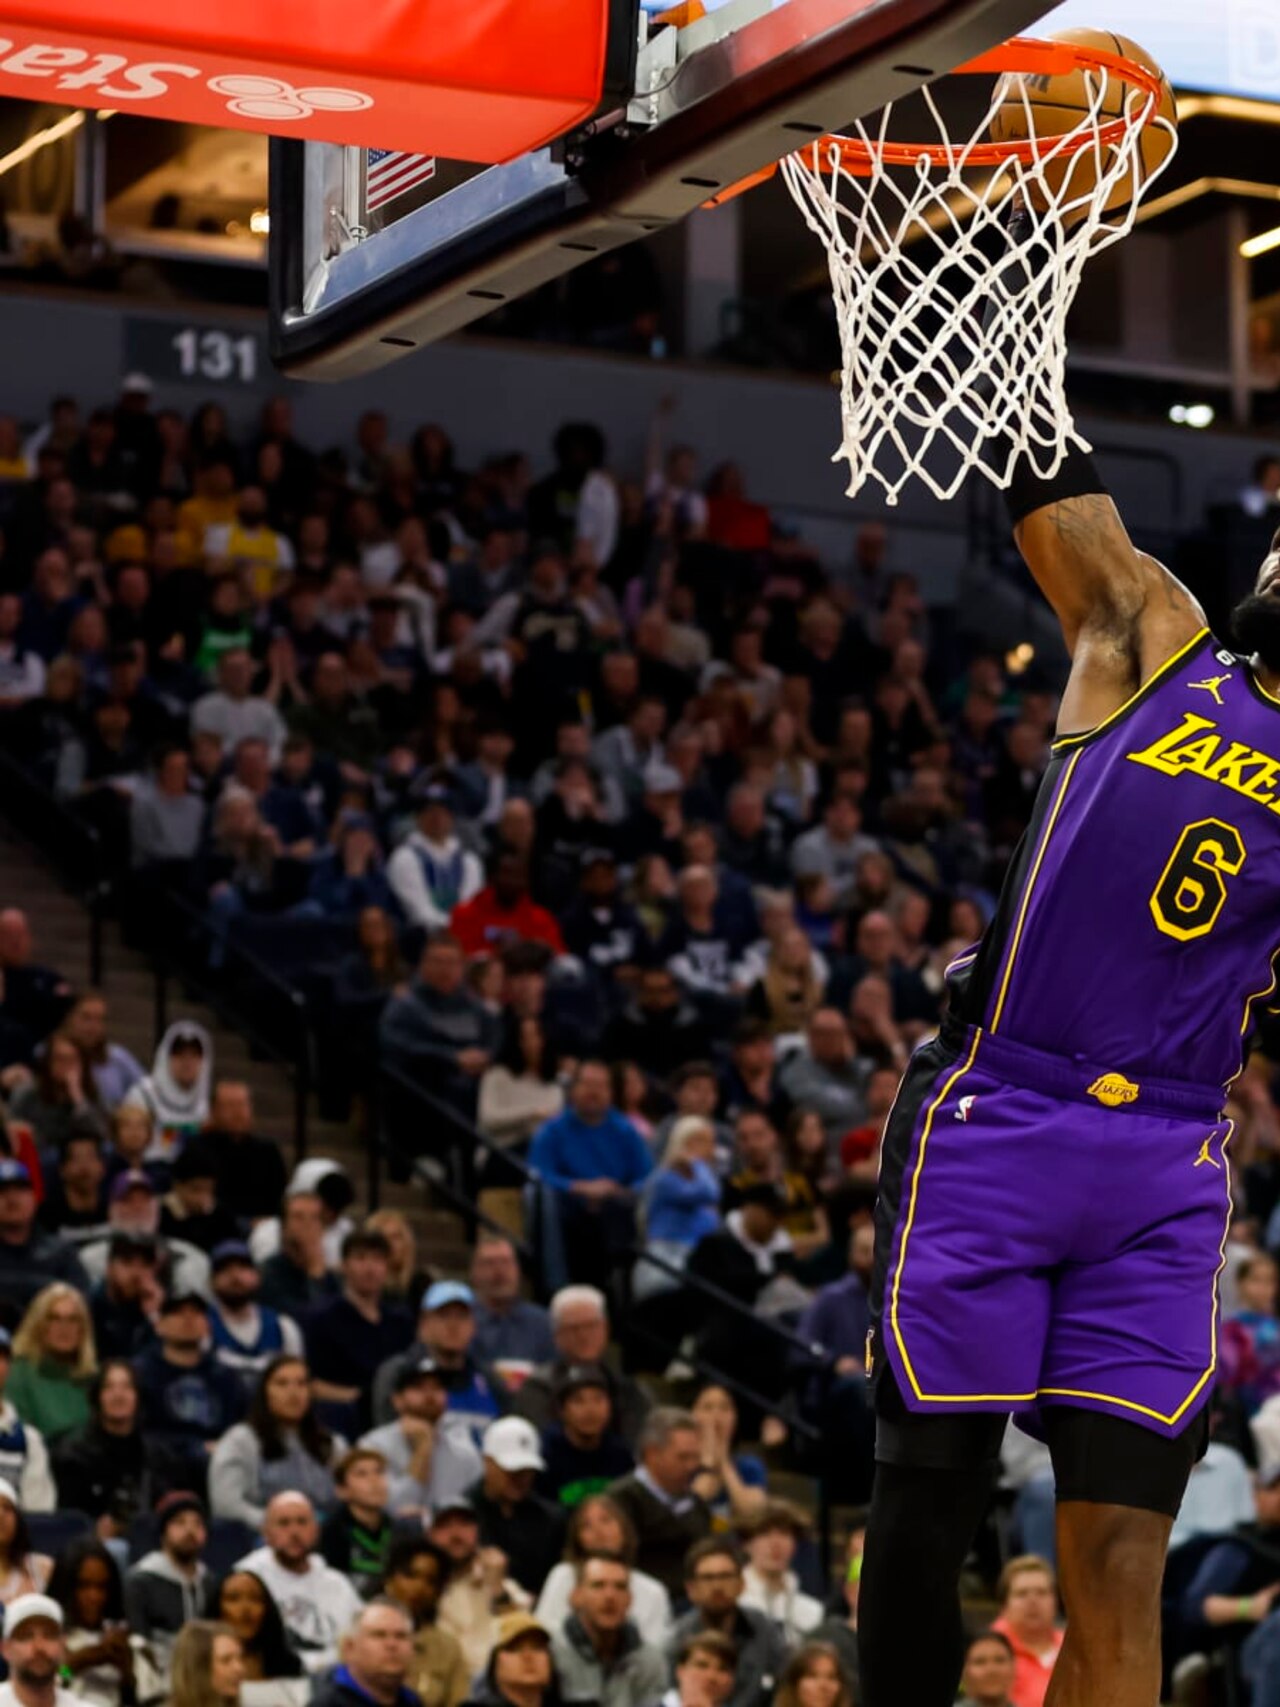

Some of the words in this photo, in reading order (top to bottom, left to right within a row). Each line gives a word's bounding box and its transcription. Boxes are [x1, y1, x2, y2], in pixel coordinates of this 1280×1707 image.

[0, 38, 201, 99] Sta
[171, 327, 258, 384] 131
[1215, 649, 1236, 666] 6
[1149, 817, 1247, 942] 6
